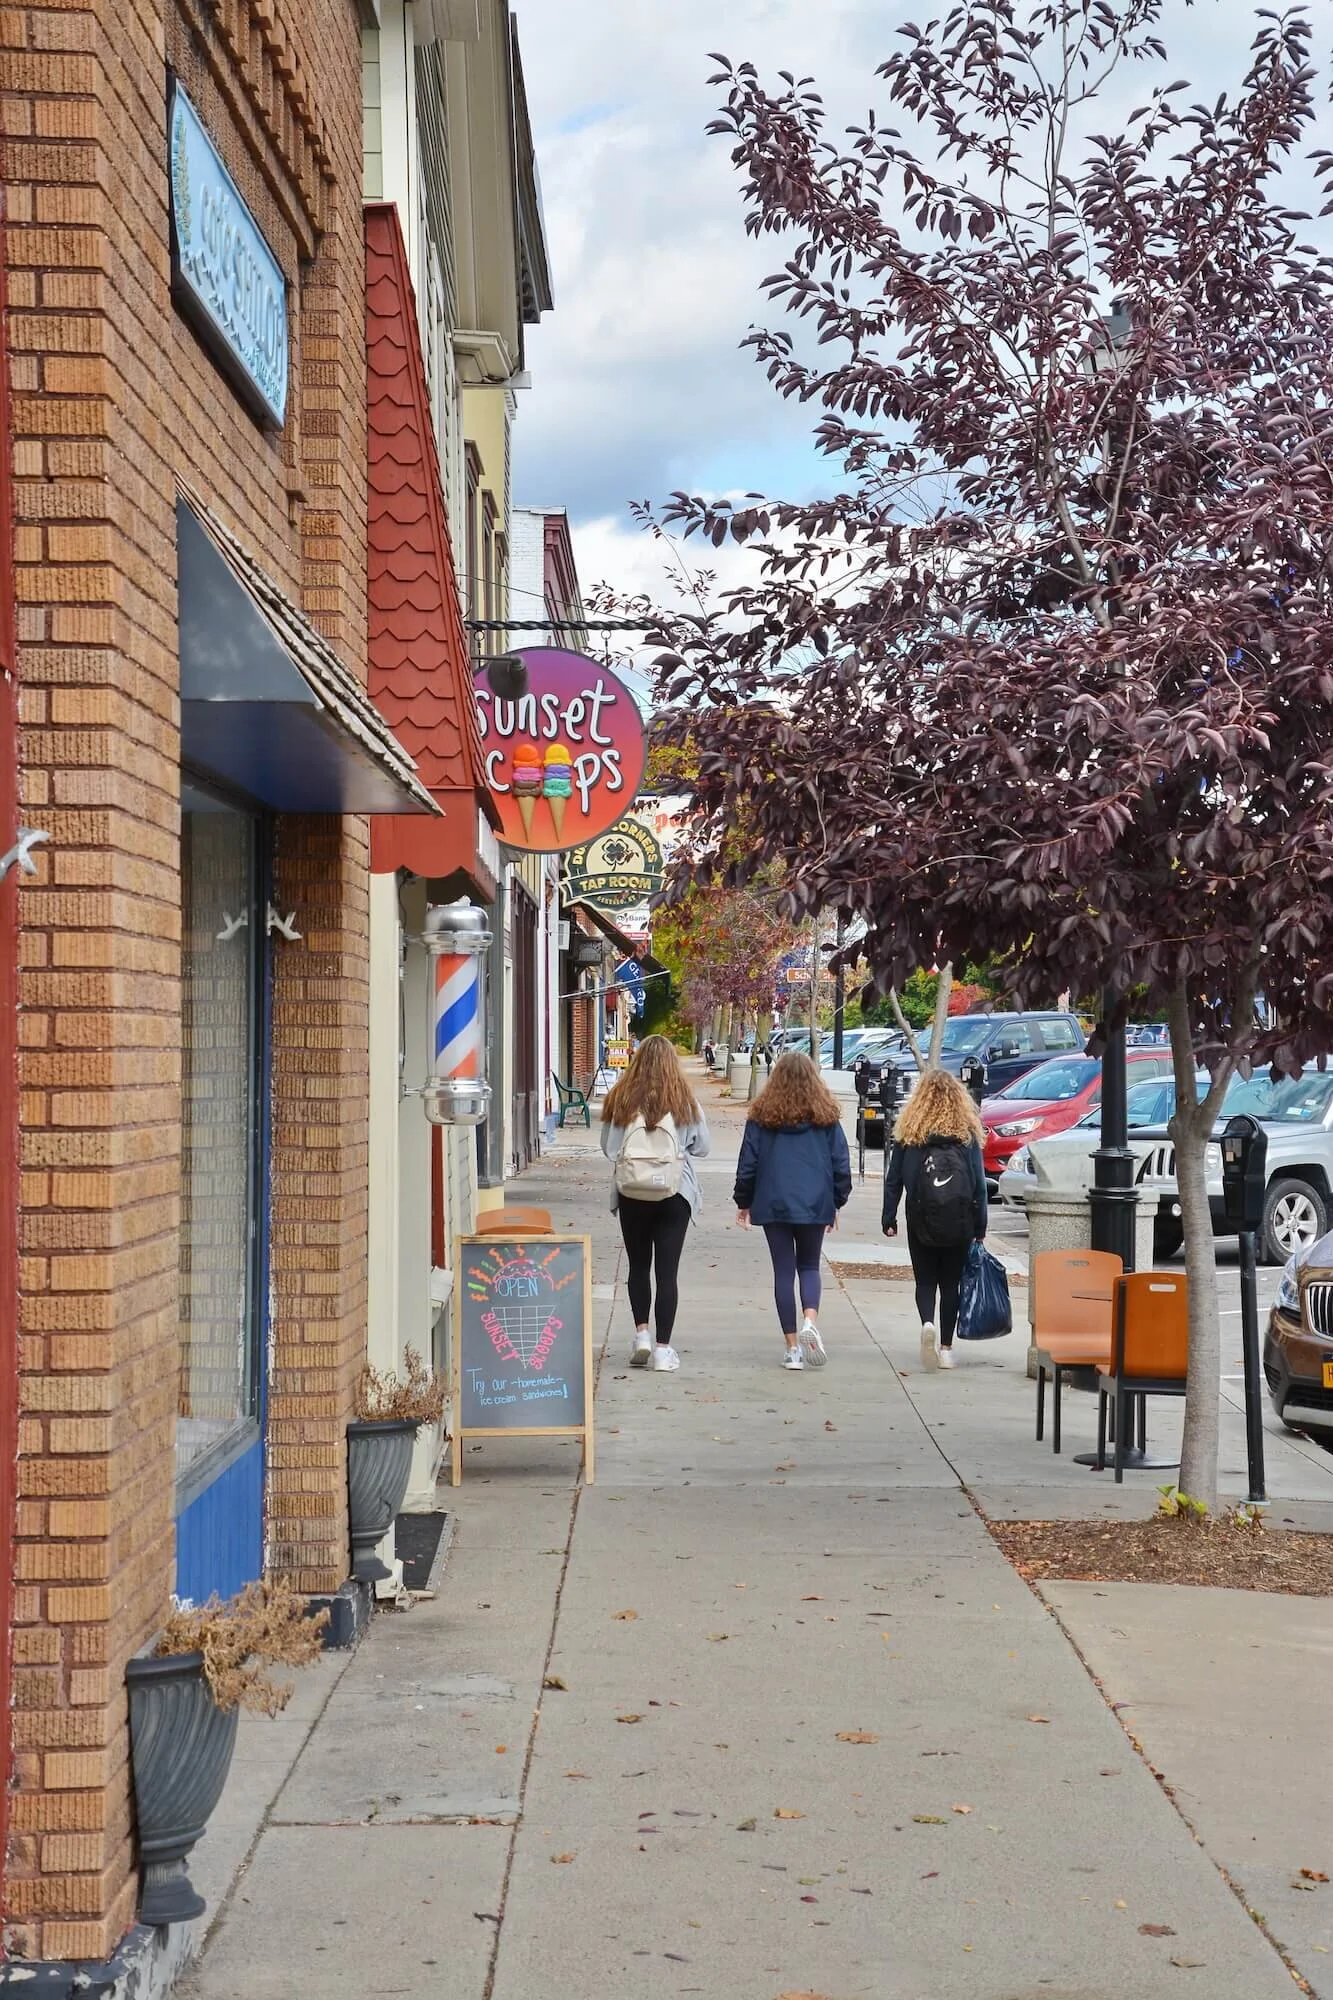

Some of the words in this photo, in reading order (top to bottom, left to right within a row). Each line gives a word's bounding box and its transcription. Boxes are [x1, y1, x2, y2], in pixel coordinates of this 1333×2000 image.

[580, 876, 606, 891] TAP
[609, 876, 652, 890] ROOM
[609, 1048, 628, 1056] SALE
[499, 1277, 539, 1297] OPEN
[480, 1312, 521, 1361] SUNSET
[530, 1315, 564, 1370] SCOOPS
[466, 1368, 485, 1396] Try
[492, 1379, 507, 1391] our
